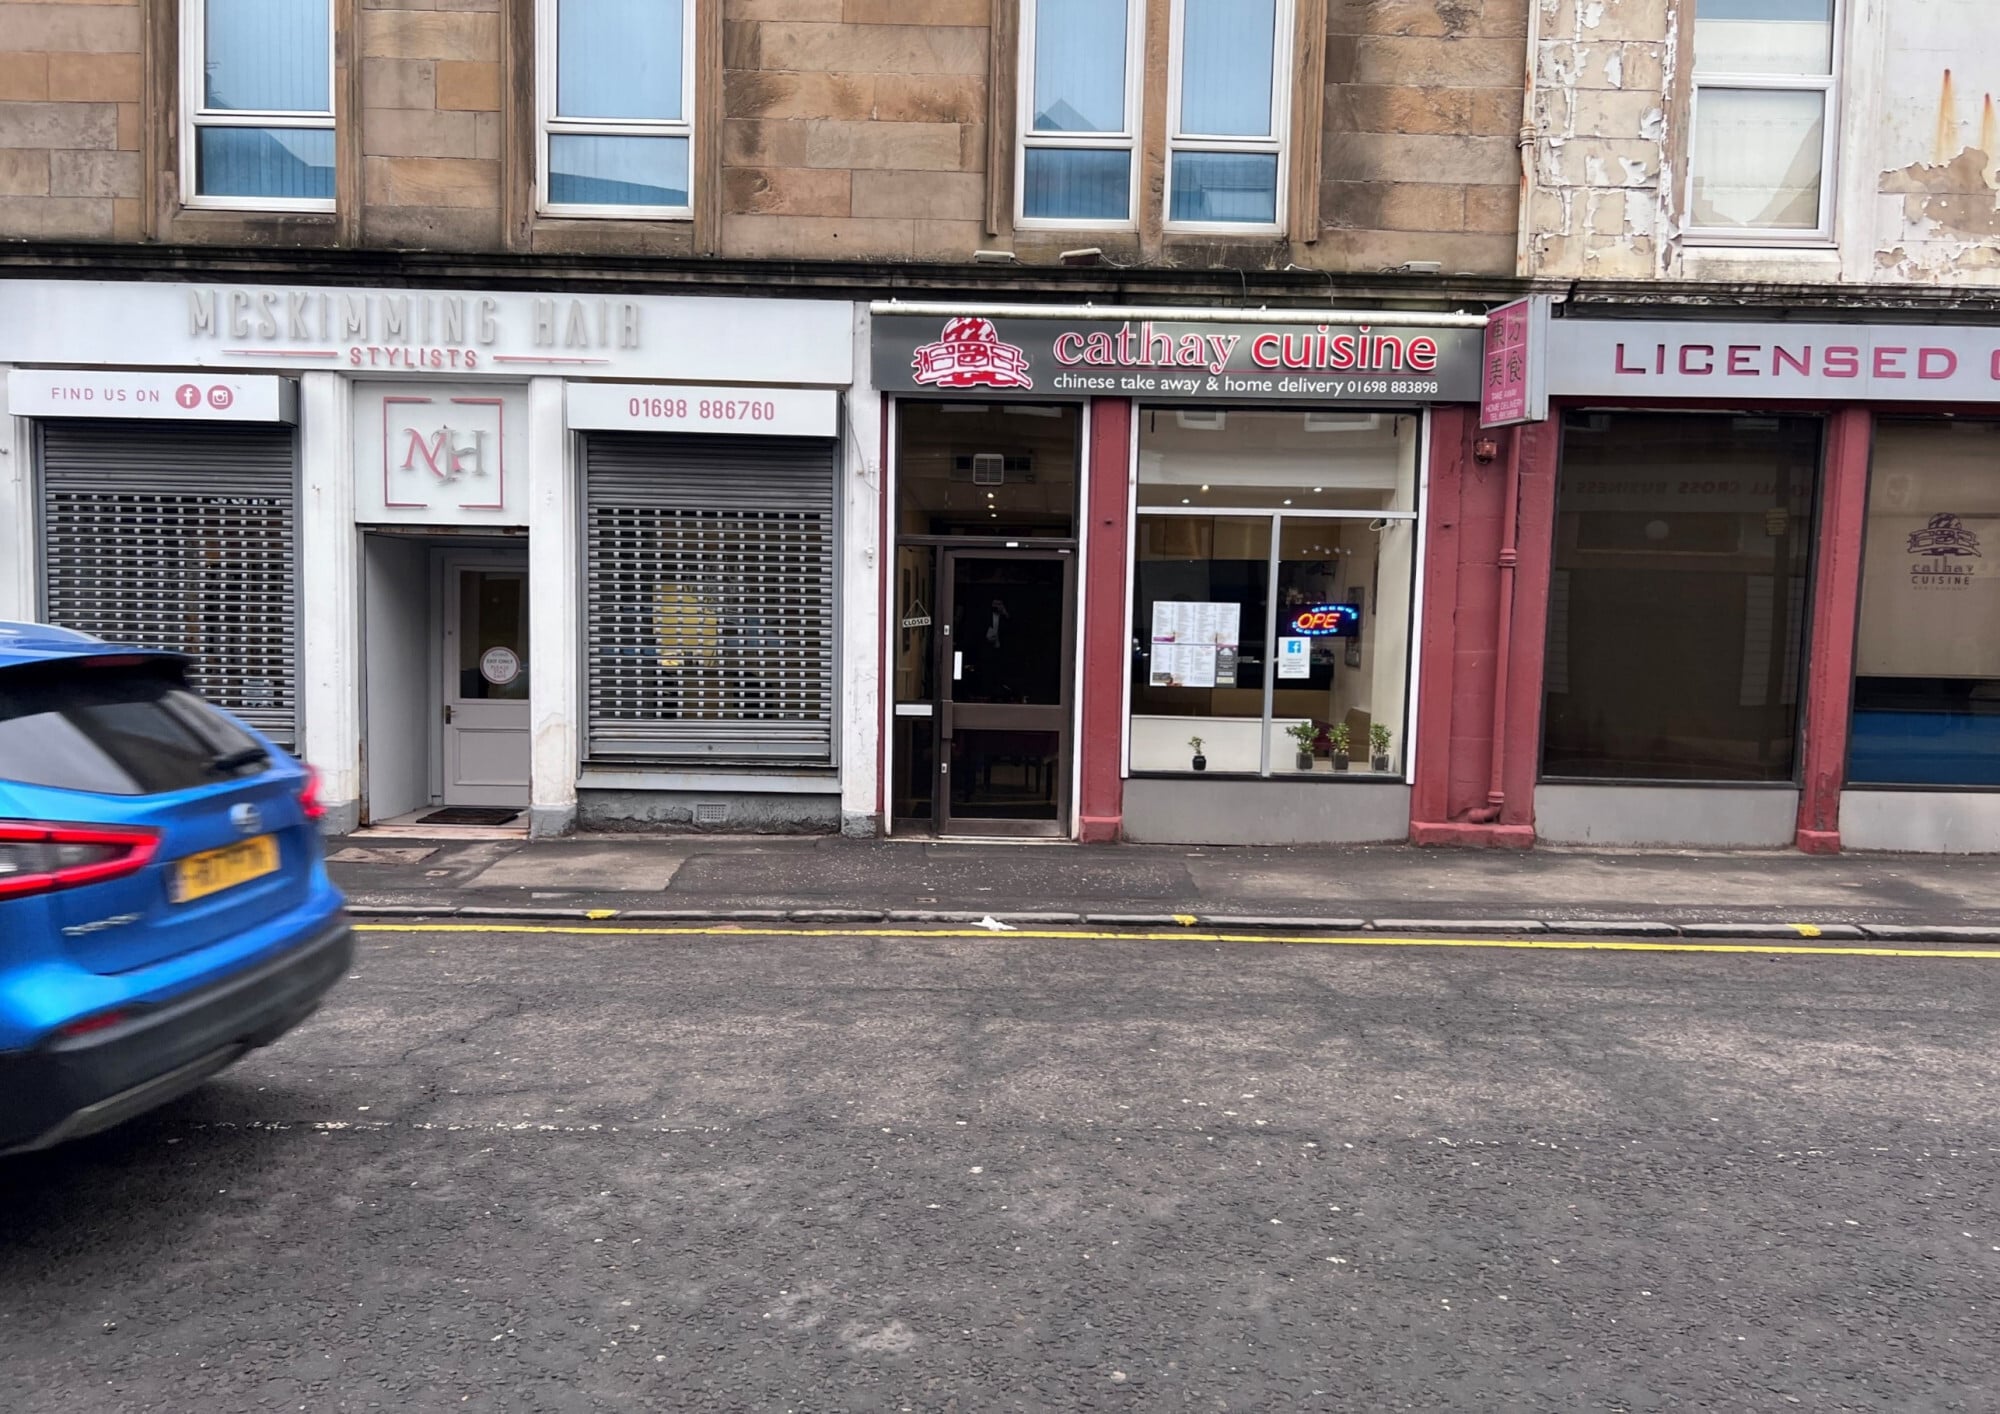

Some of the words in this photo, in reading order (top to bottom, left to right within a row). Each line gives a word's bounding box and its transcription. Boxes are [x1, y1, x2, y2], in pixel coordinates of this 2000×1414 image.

[189, 289, 496, 345] MCSKIMMING
[533, 298, 639, 349] HAIR
[350, 347, 478, 369] STYLISTS
[1053, 320, 1240, 374] cathay
[1252, 324, 1438, 371] cuisine
[1615, 343, 1958, 379] LICENSED
[52, 387, 94, 400] FIND
[104, 389, 126, 401] US
[136, 390, 159, 402] ON
[1054, 373, 1115, 389] chinese
[1121, 375, 1155, 390] take
[1160, 378, 1201, 394] away
[1206, 377, 1219, 391] &
[1225, 377, 1272, 392] home
[1278, 377, 1344, 397] delivery
[1348, 381, 1387, 393] 01698
[1391, 381, 1438, 394] 883898
[629, 398, 687, 418] 01698
[699, 400, 775, 420] 886760
[1911, 576, 1970, 585] CUISINE
[903, 618, 930, 627] CLOSED
